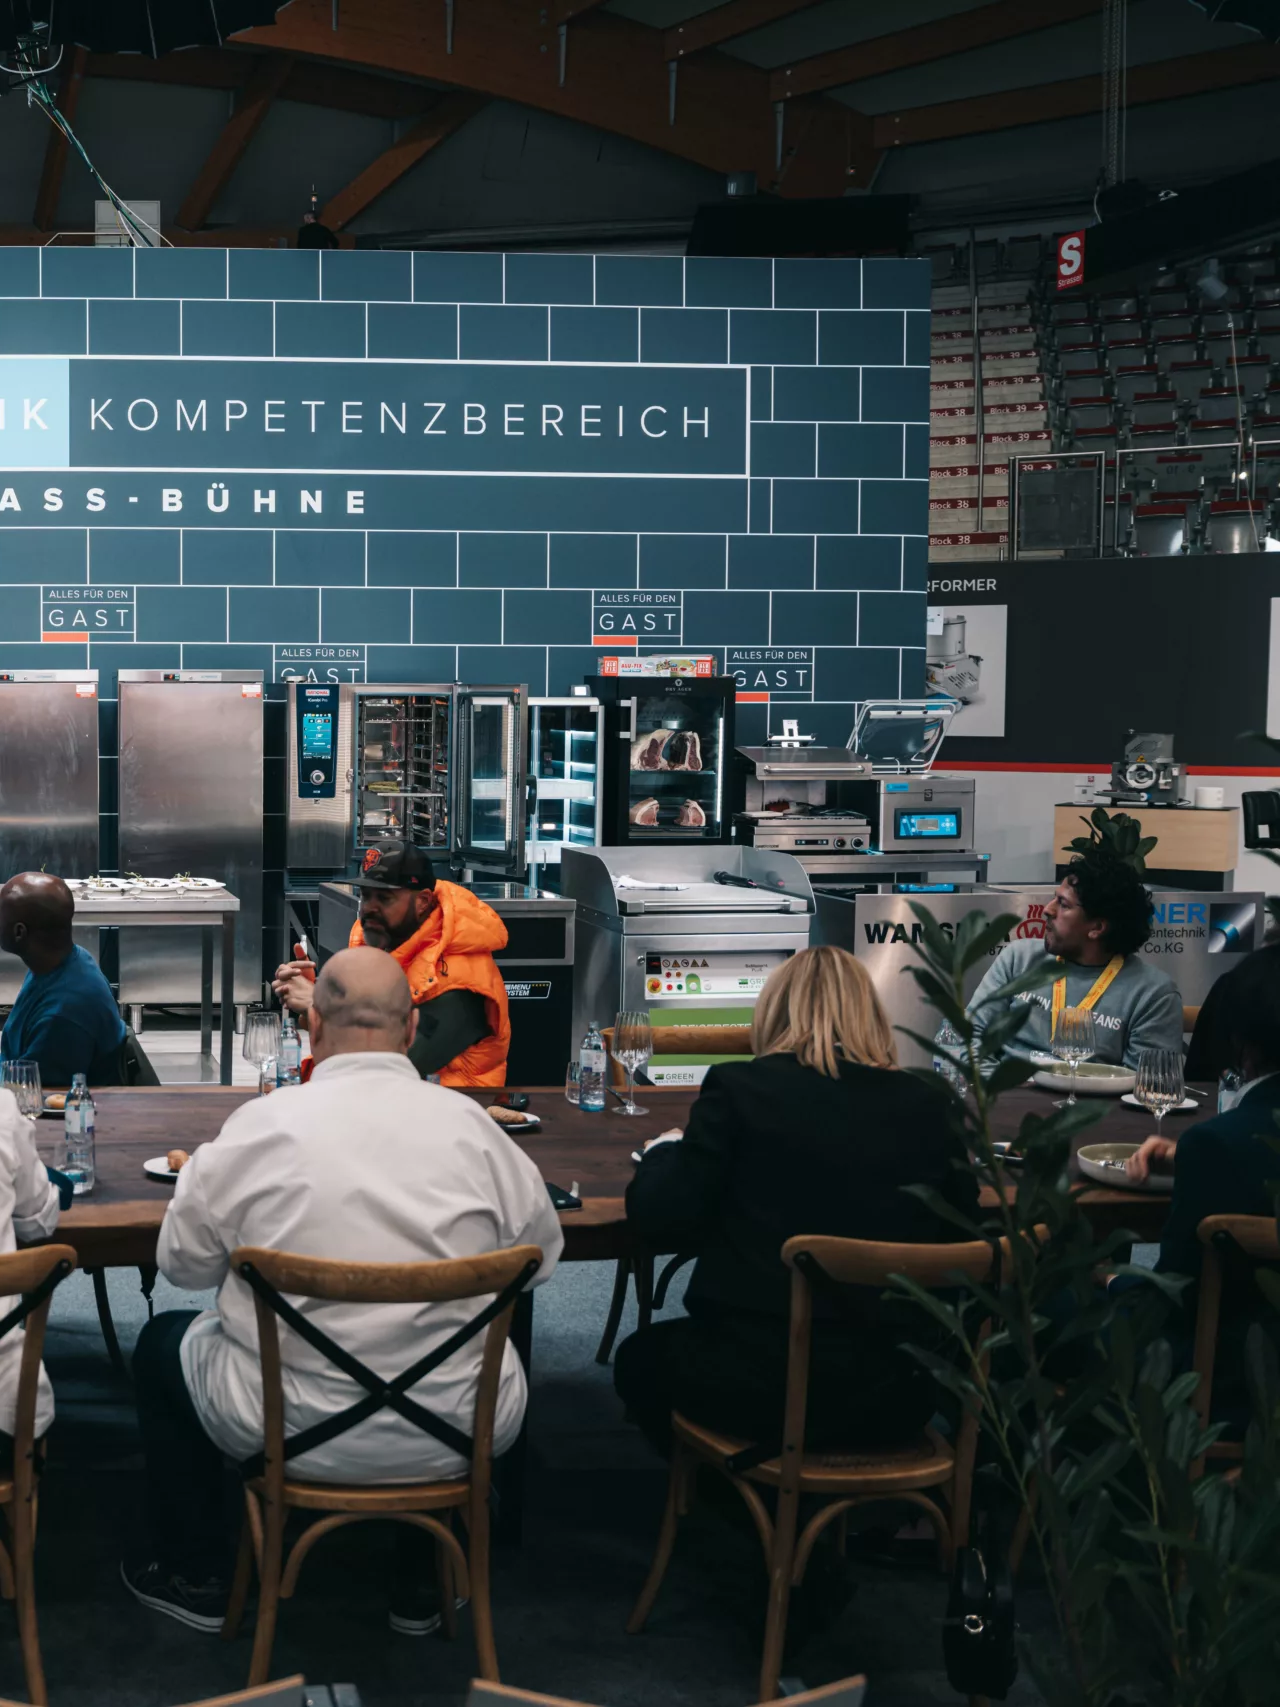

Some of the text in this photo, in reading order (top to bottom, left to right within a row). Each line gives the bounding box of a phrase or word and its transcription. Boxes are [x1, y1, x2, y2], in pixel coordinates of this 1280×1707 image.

[1059, 237, 1082, 276] S
[1058, 273, 1083, 289] Strasser
[955, 408, 966, 416] 38
[1016, 404, 1027, 412] 39
[90, 398, 709, 438] KOMPETENZBEREICH
[930, 437, 967, 447] Block 38
[1018, 433, 1030, 442] 39
[930, 468, 969, 478] Block 38
[930, 500, 969, 510] Block 38
[930, 535, 971, 545] Block 38
[48, 588, 128, 599] ALLES FÜR DEN
[600, 592, 676, 603] ALLES FÜR DEN
[48, 609, 129, 627] GAST
[599, 613, 677, 631] GAST
[282, 647, 360, 657] ALLES FÜR DEN
[733, 649, 808, 660] ALLES FÜR DEN
[281, 667, 360, 684] GAST
[732, 670, 808, 687] GAST
[1150, 903, 1207, 924] NER
[1151, 927, 1205, 938] entechnik
[1144, 942, 1184, 954] Co.KG
